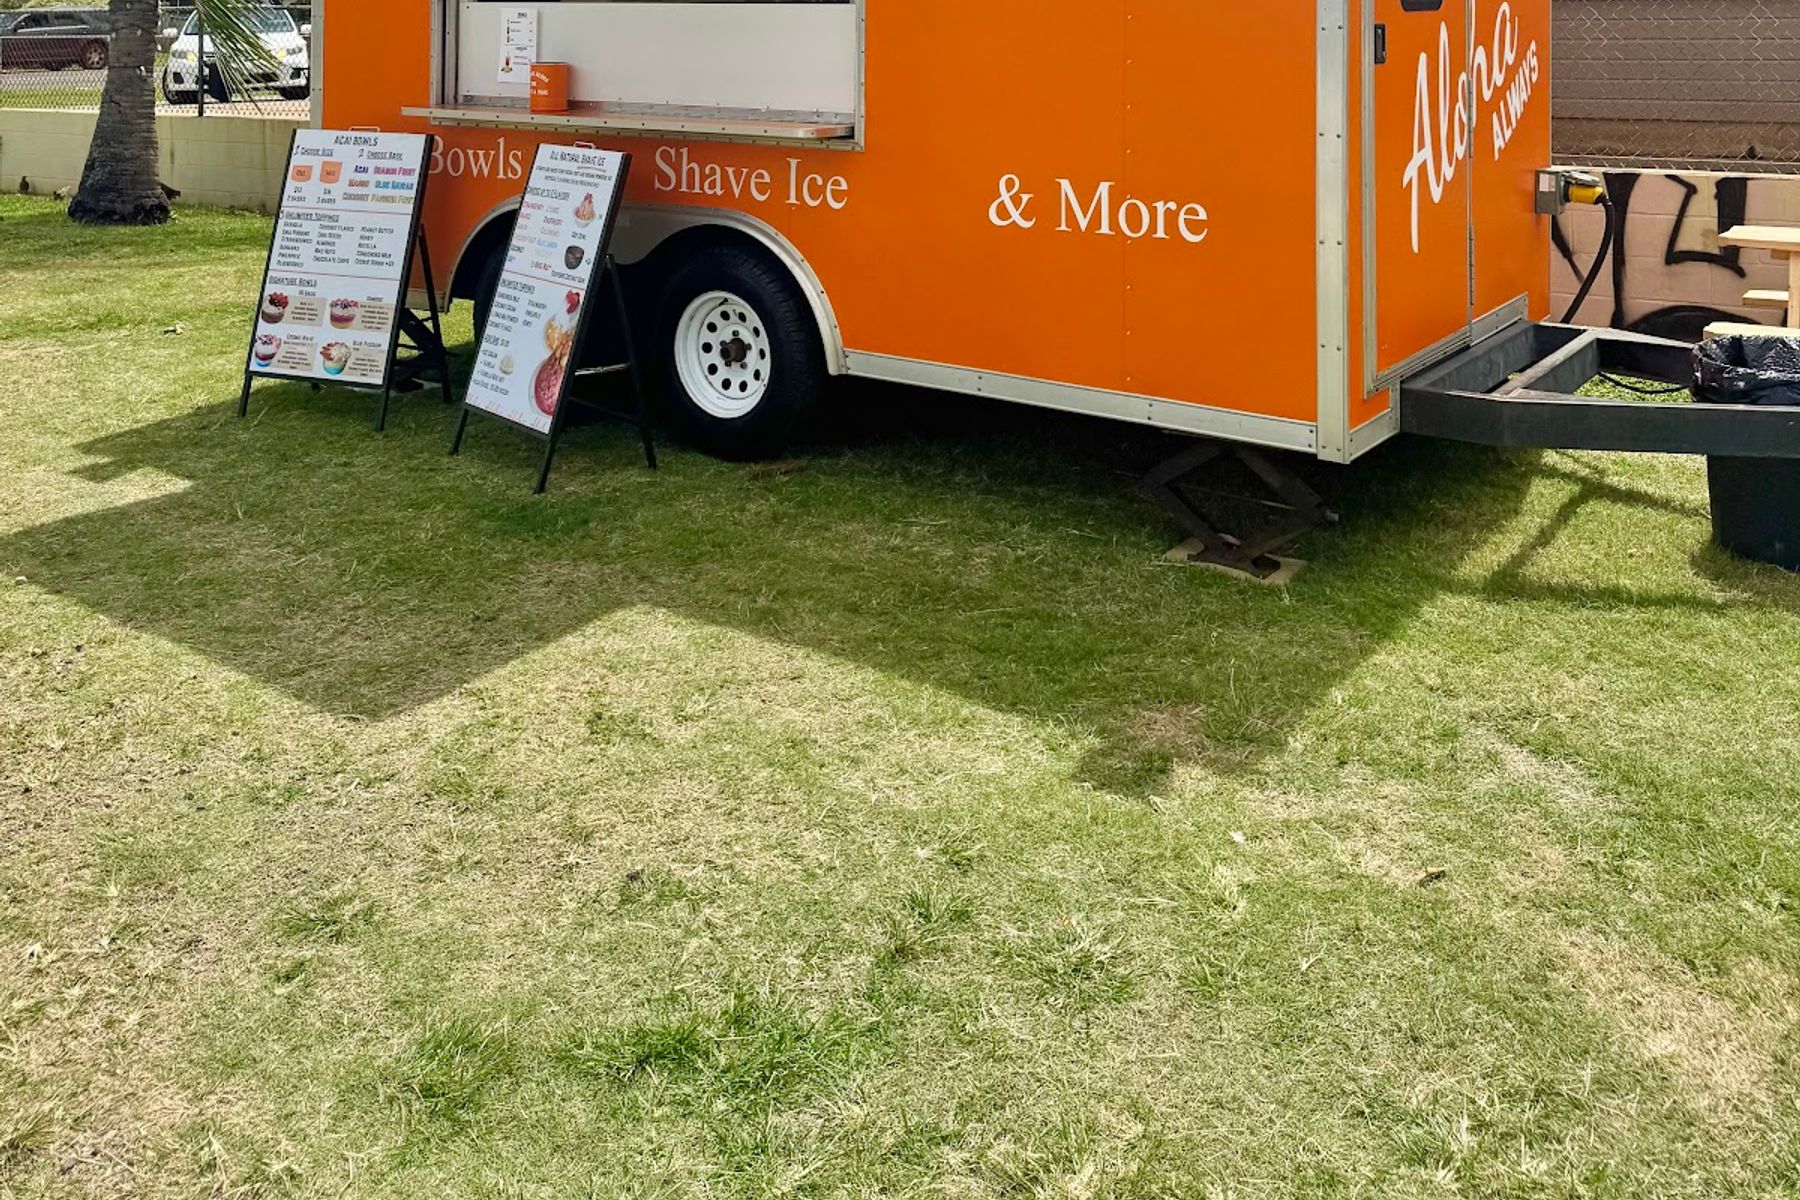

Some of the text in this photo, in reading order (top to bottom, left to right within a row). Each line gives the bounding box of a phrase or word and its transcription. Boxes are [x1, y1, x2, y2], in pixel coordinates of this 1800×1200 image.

[334, 136, 378, 147] ACAI BOWLS
[1492, 40, 1539, 161] ALWAYS
[428, 136, 1208, 243] Bowls Shave Ice & More
